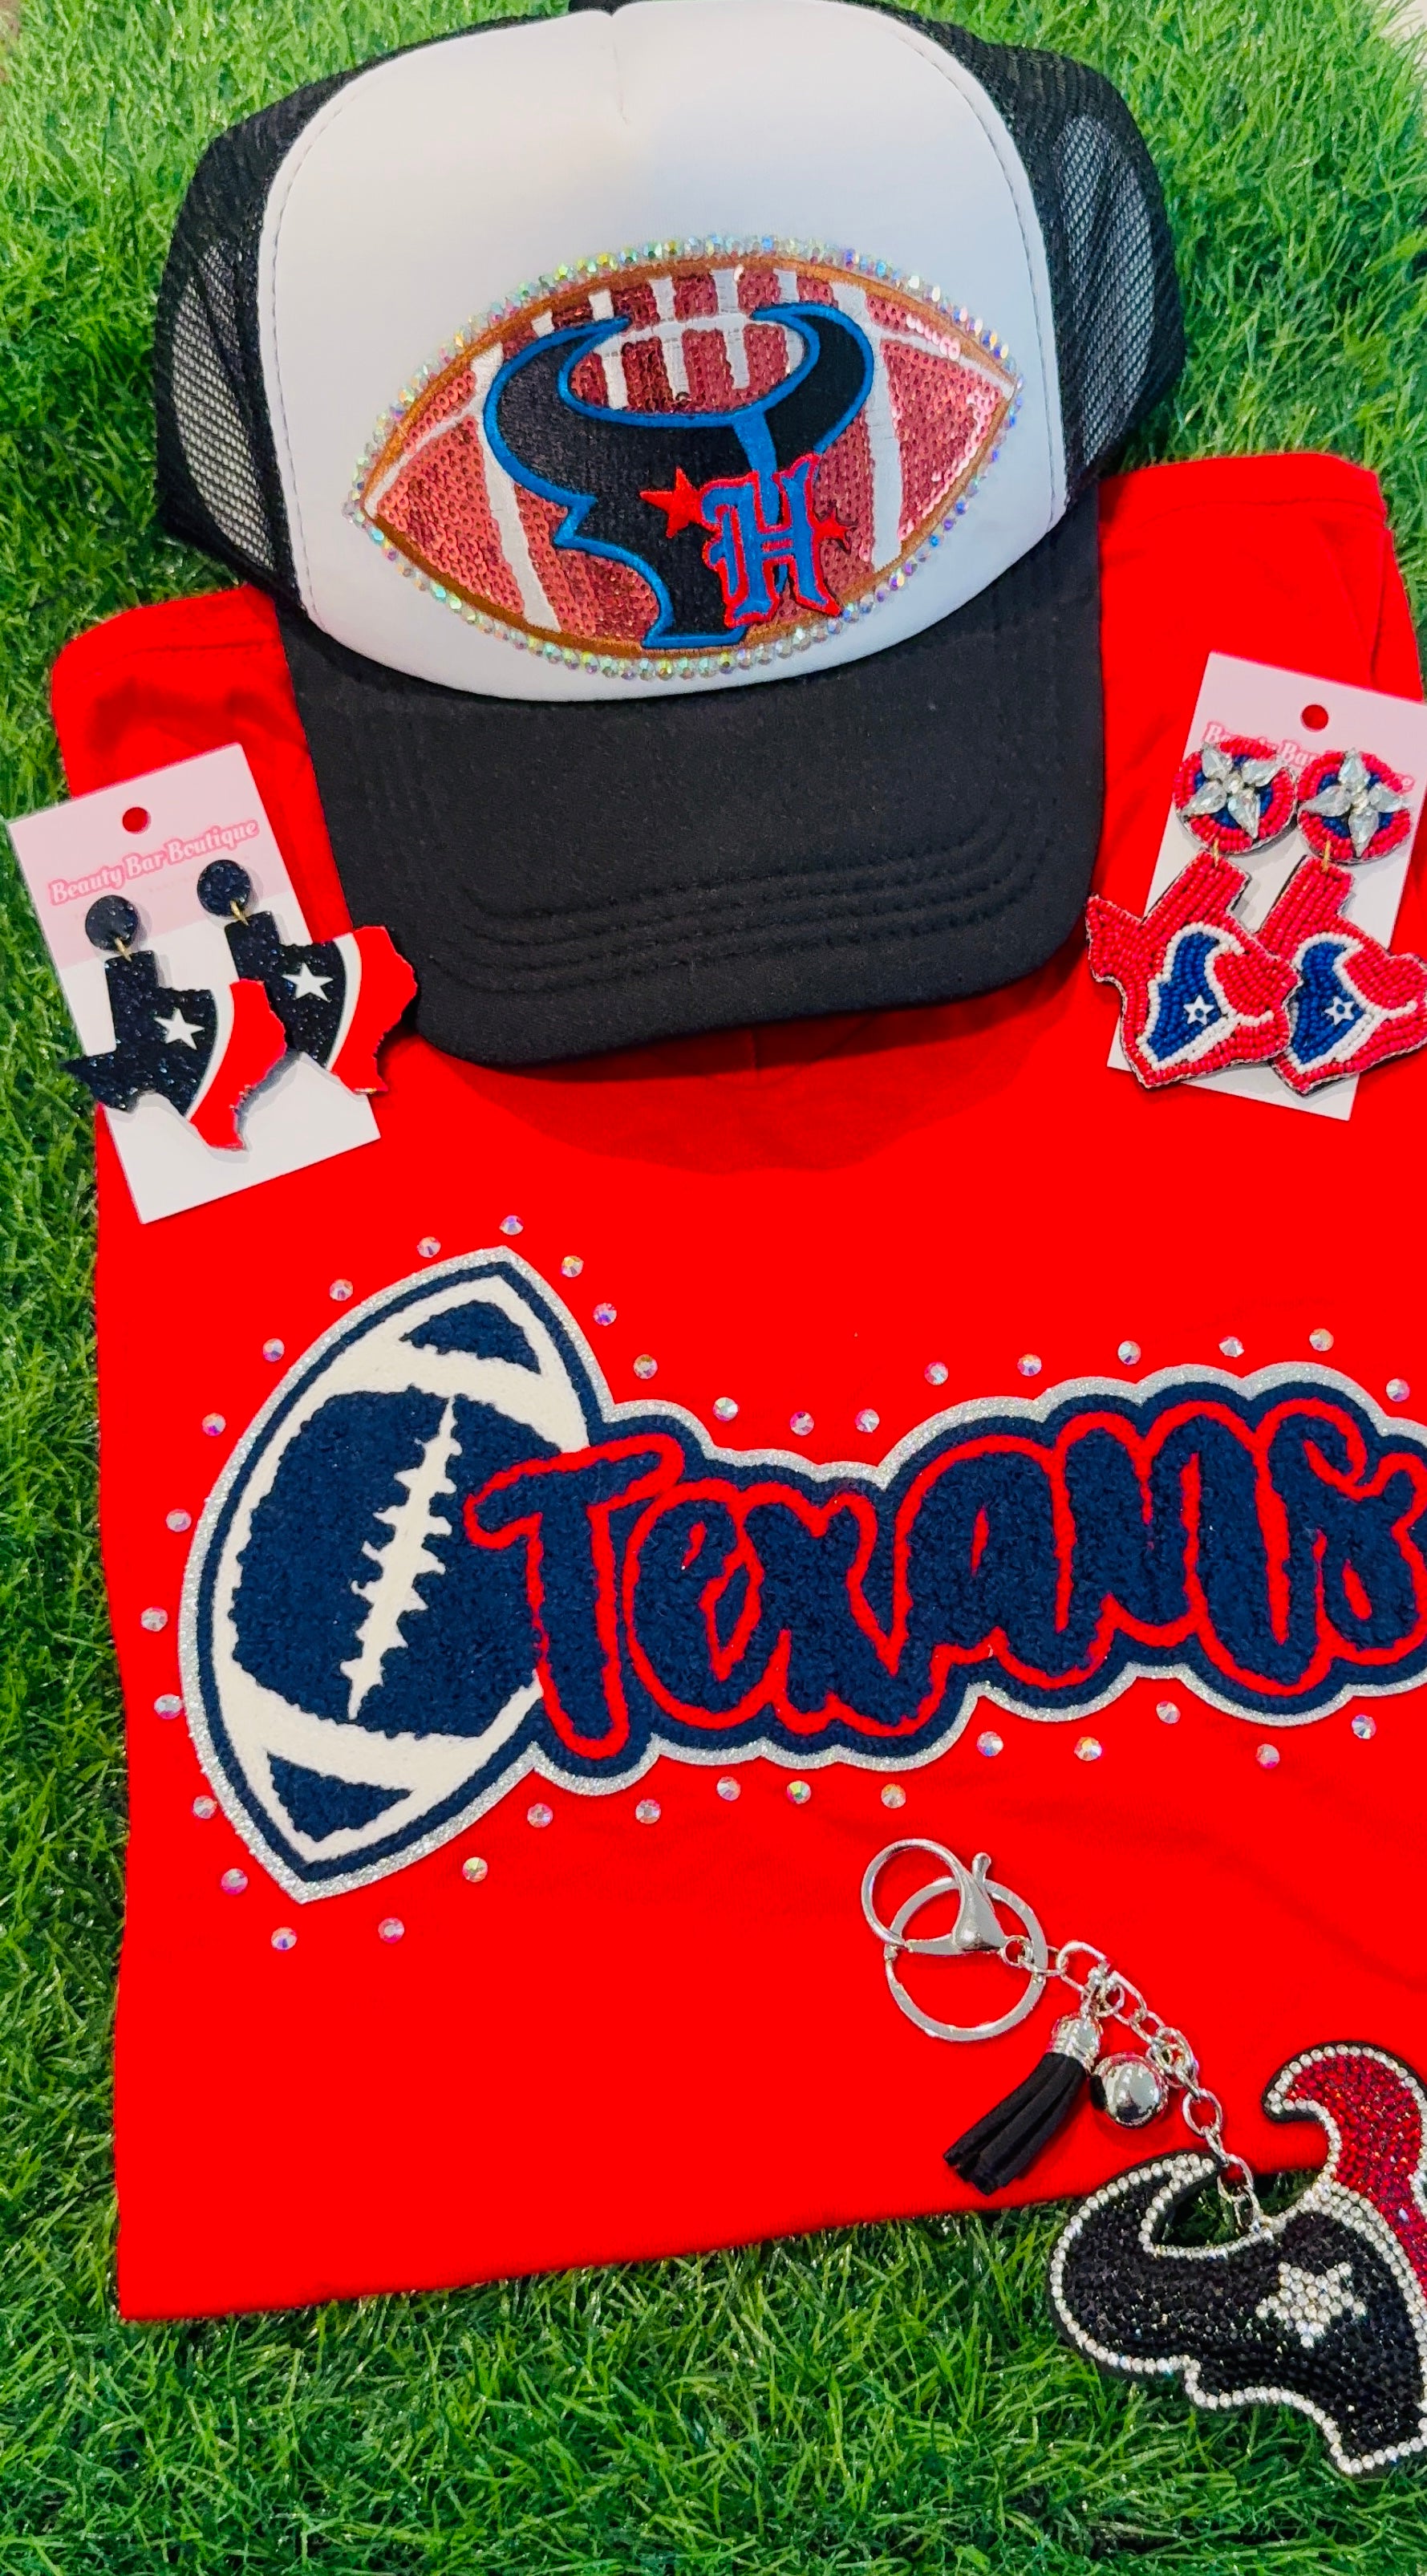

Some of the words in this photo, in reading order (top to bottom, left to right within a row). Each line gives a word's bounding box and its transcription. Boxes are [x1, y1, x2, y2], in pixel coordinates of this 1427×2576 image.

[697, 452, 841, 627] H
[49, 866, 125, 906] Beauty
[125, 854, 165, 880] Bar
[164, 821, 259, 865] Boutique
[464, 1398, 1427, 1757] Texans
